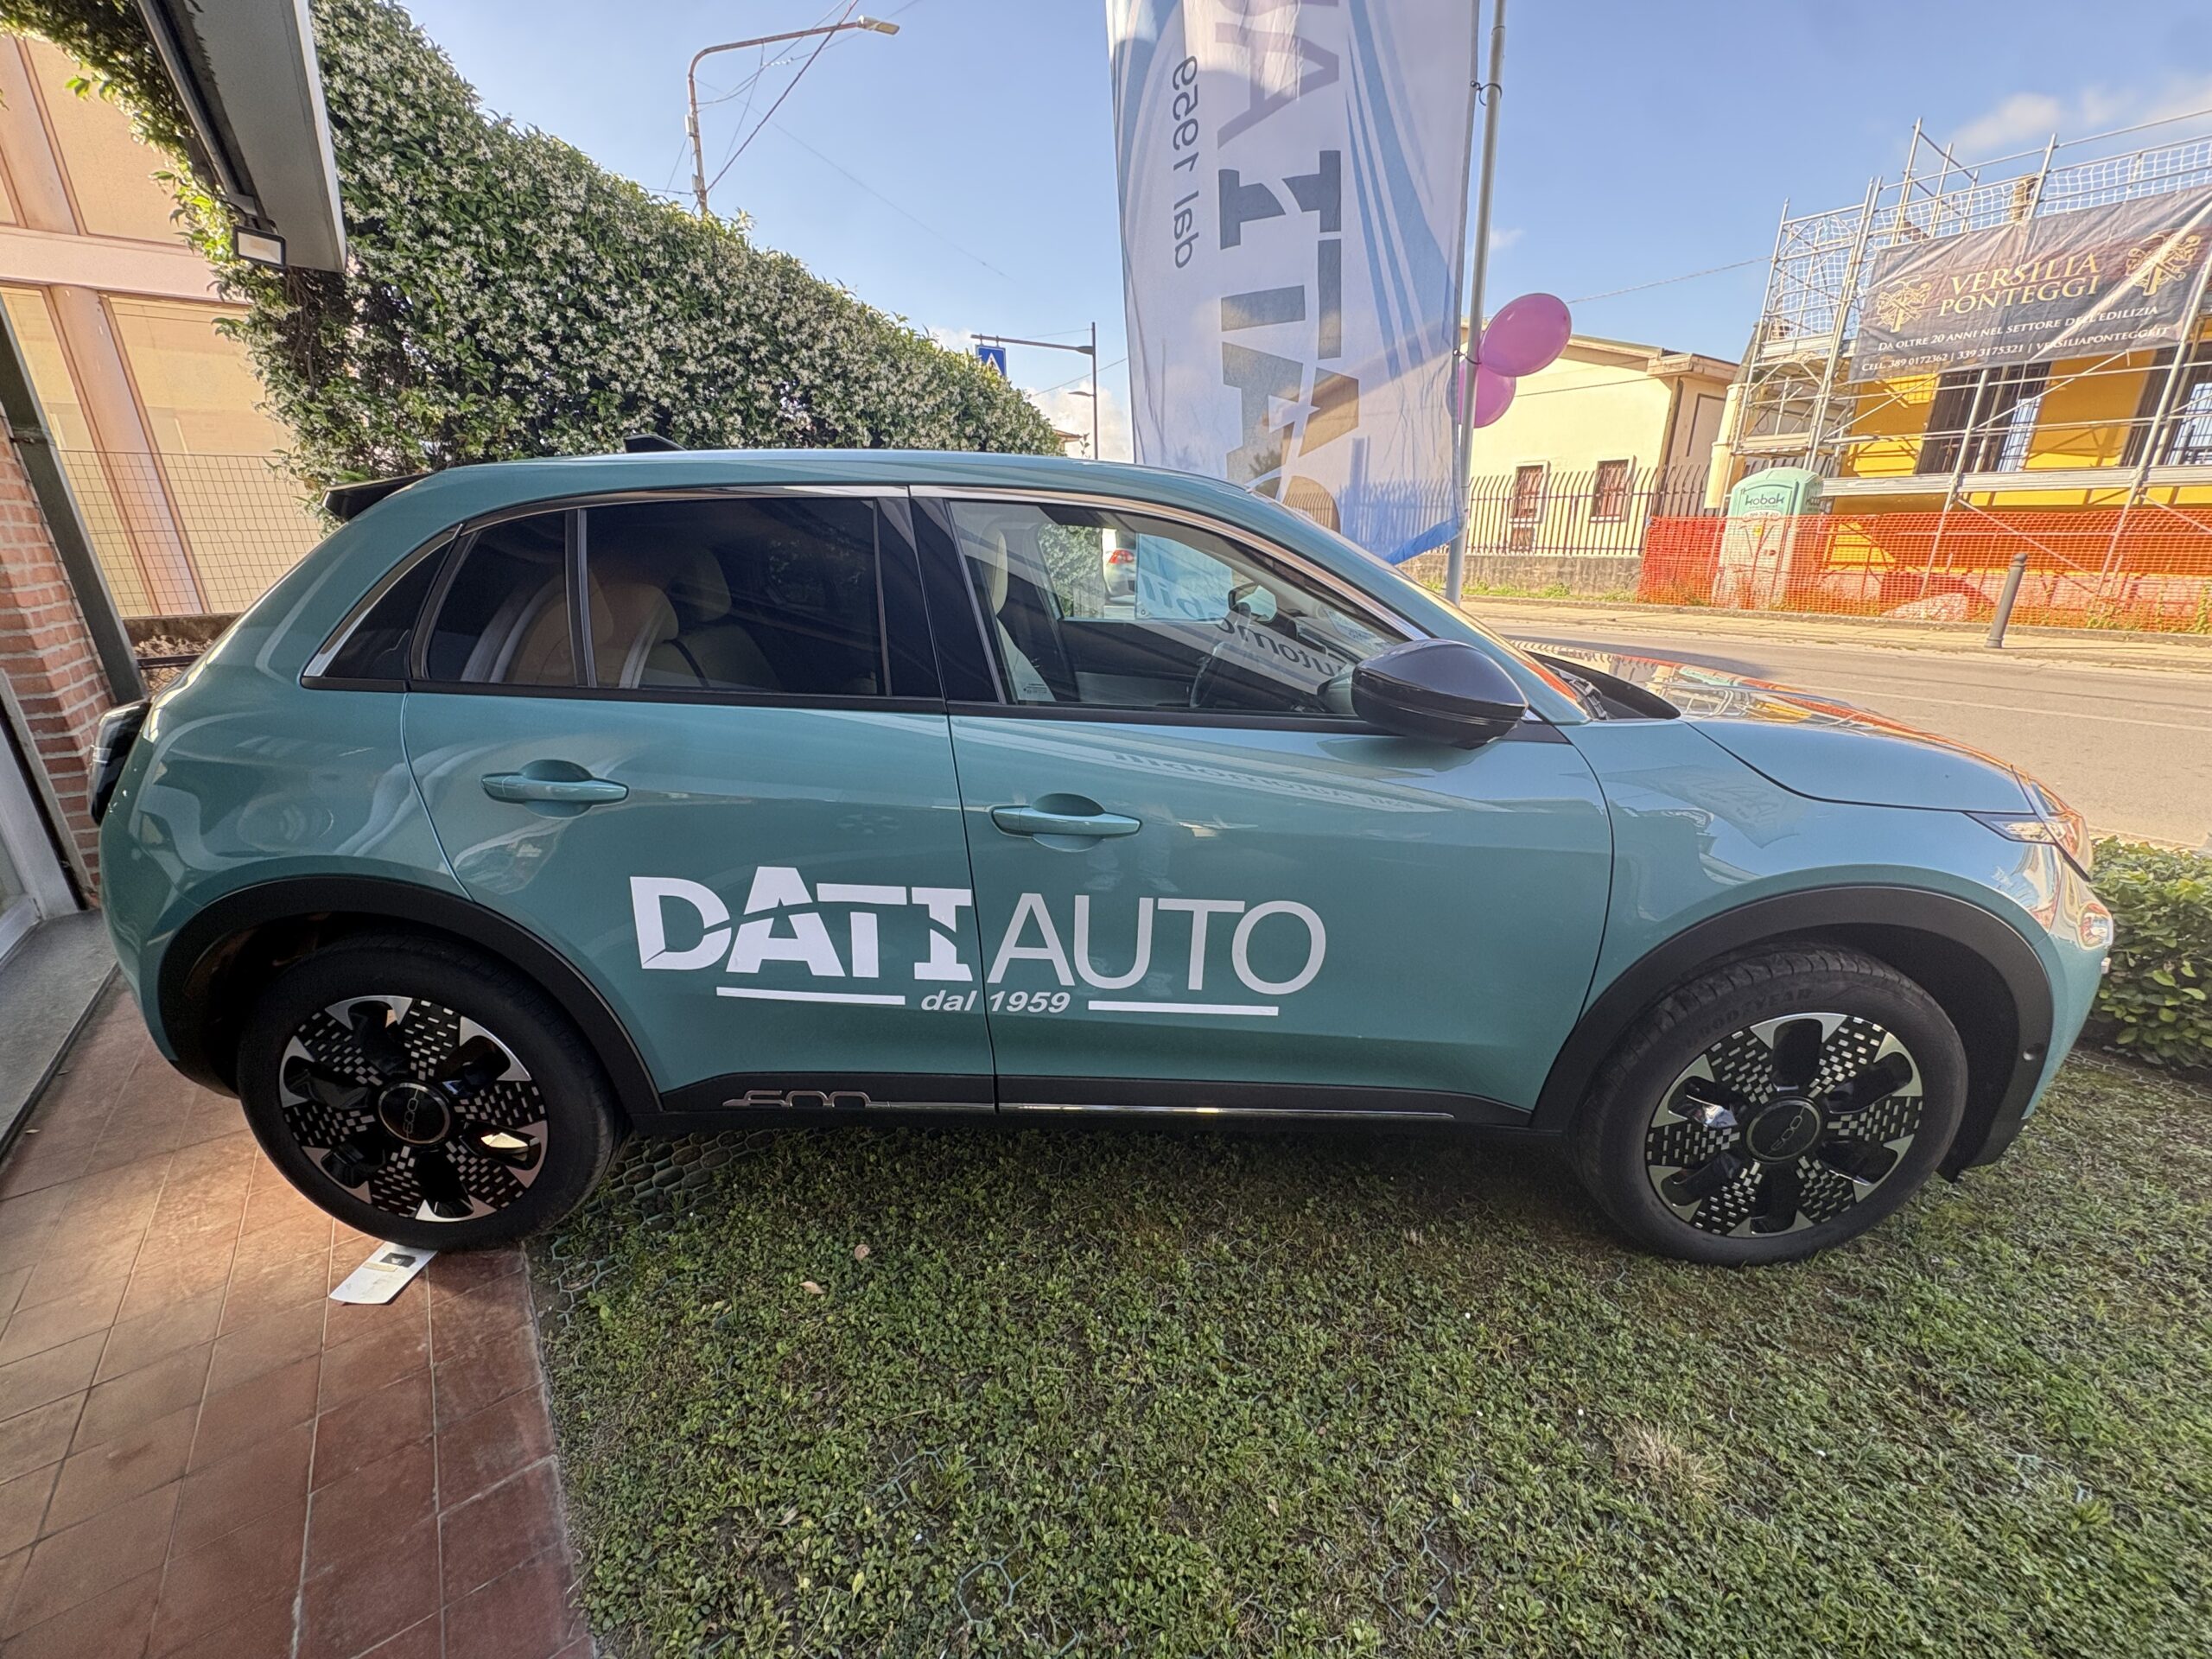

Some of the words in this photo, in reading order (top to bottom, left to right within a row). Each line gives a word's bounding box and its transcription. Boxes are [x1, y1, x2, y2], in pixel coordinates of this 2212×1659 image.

[1951, 252, 2100, 296] VERSILIA
[1937, 275, 2101, 317] PONTEGGI
[1878, 342, 1894, 352] DA
[1896, 337, 1929, 349] OLTRE
[1931, 334, 1945, 344] 20
[1946, 329, 1978, 342] ANNI
[1980, 327, 2003, 338] NEL
[2005, 319, 2062, 334] SETTORE
[1956, 349, 1977, 360] 339
[1977, 344, 2024, 357] 3175321
[1745, 493, 1785, 505] kobak
[630, 866, 974, 982] DATI
[987, 893, 1327, 995] AUTO
[920, 988, 977, 1014] dal
[988, 991, 1071, 1014] 1959
